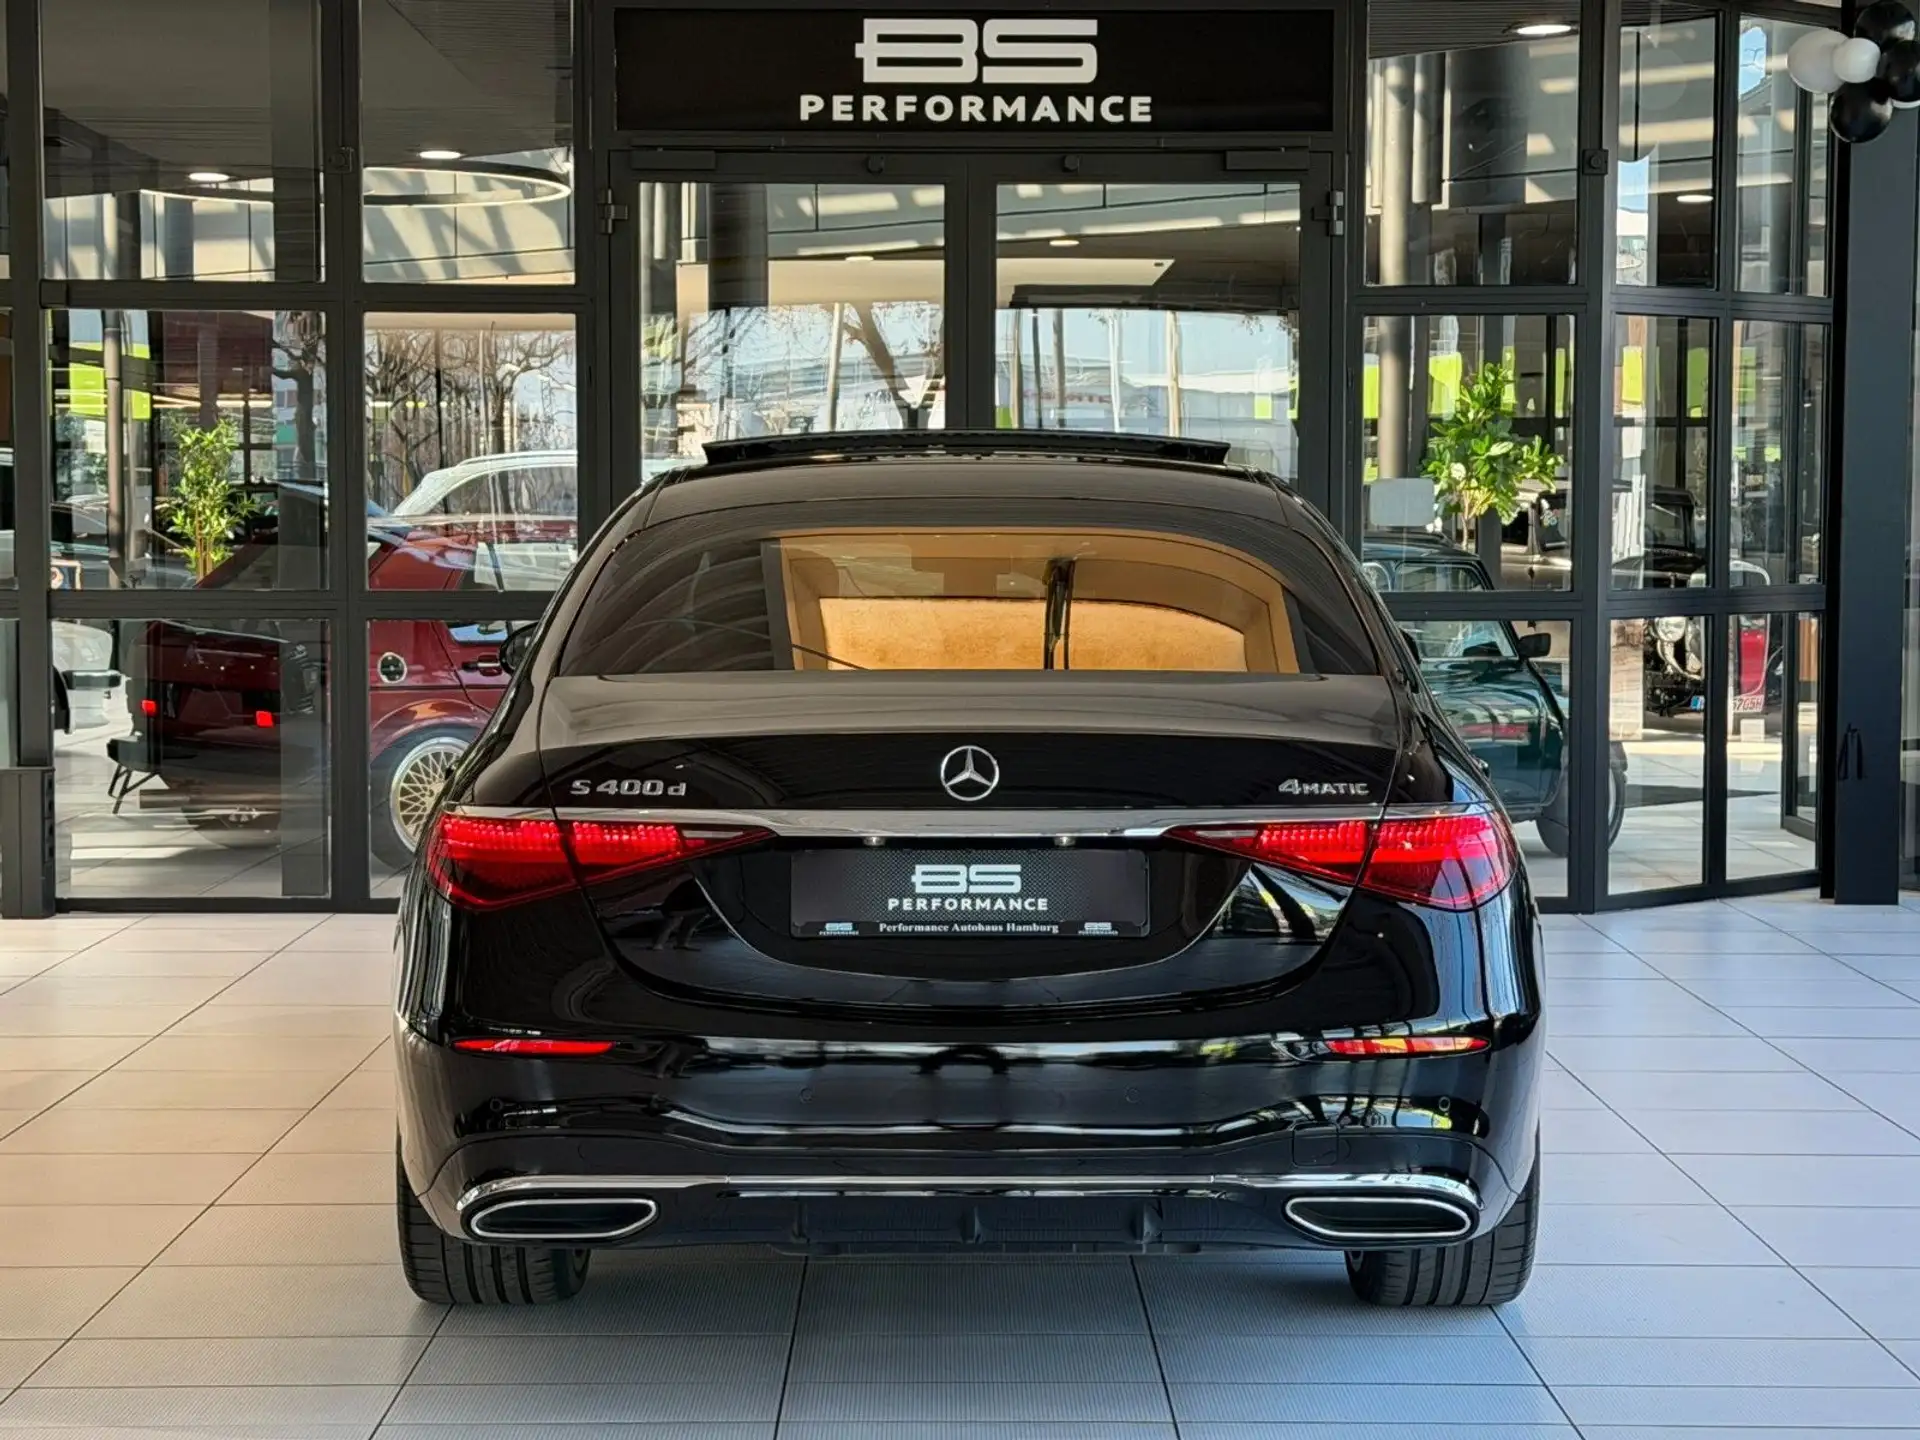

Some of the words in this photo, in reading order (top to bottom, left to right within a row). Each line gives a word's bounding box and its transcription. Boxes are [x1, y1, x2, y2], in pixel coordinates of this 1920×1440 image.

[855, 18, 1098, 84] BS
[800, 95, 1152, 123] PERFORMANCE
[1278, 778, 1370, 795] 4MATIC
[911, 864, 1022, 894] BS
[887, 898, 1048, 911] PERFORMANCE
[879, 922, 949, 933] Performance
[951, 922, 1003, 933] Autohaus
[1006, 922, 1059, 934] Hamburg
